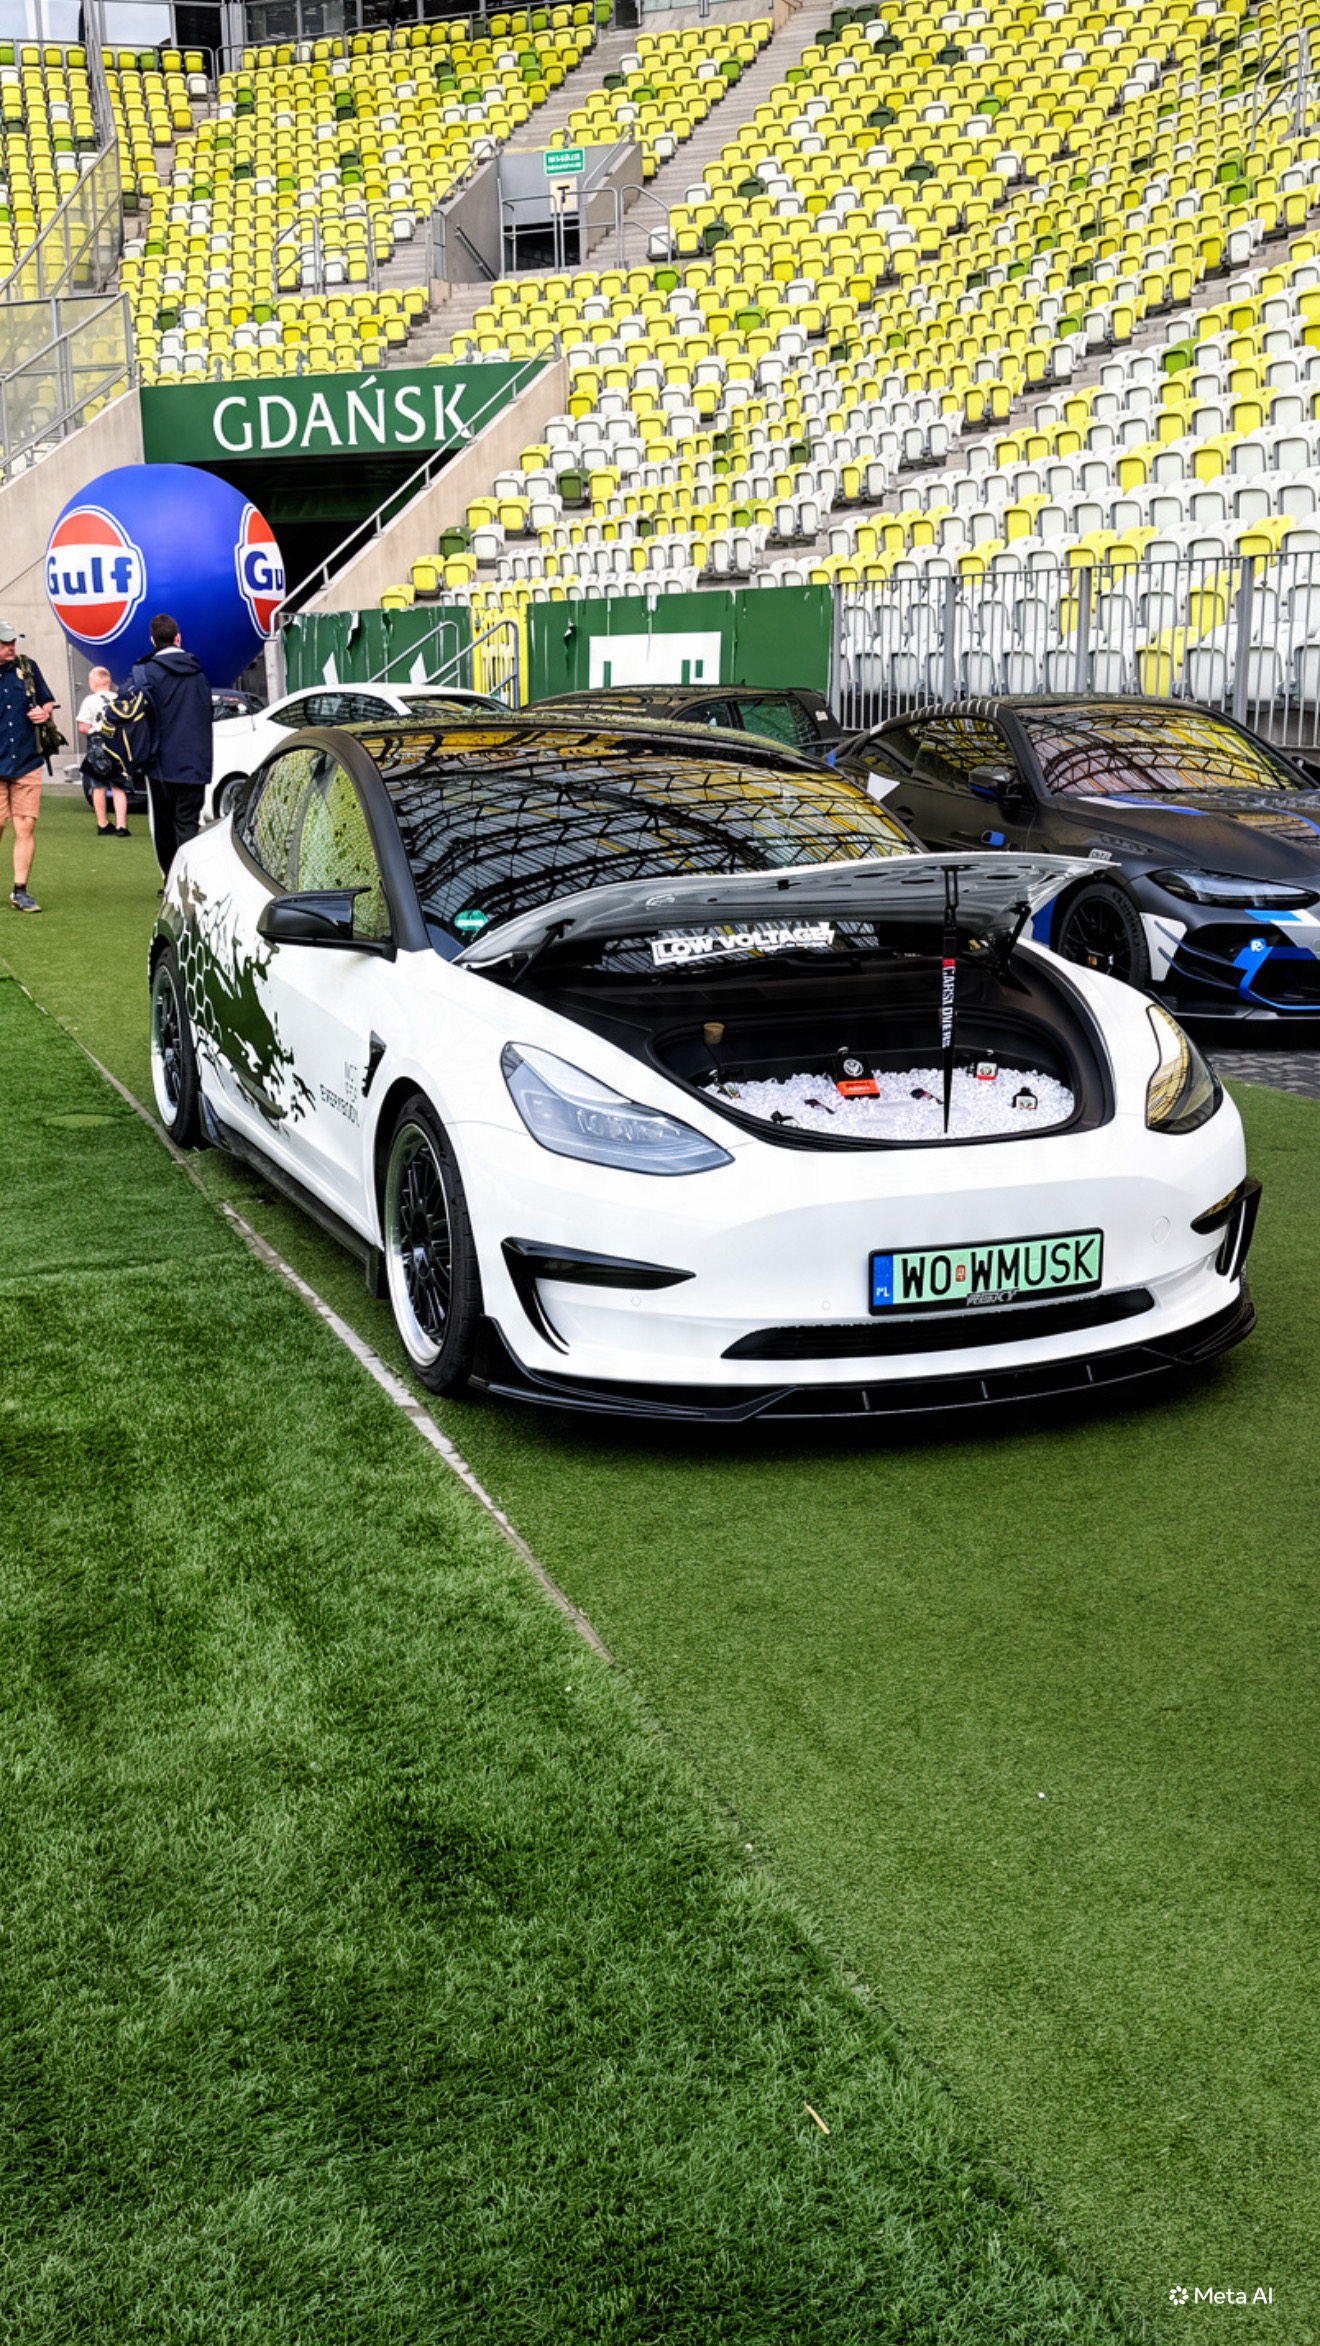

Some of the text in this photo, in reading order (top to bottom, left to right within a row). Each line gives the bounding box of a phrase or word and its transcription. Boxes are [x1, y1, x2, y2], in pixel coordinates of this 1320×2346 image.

[213, 375, 473, 452] GDAŃSK
[48, 556, 133, 595] Gulf
[658, 936, 714, 958] LOW
[971, 1238, 1096, 1292] WMUSK
